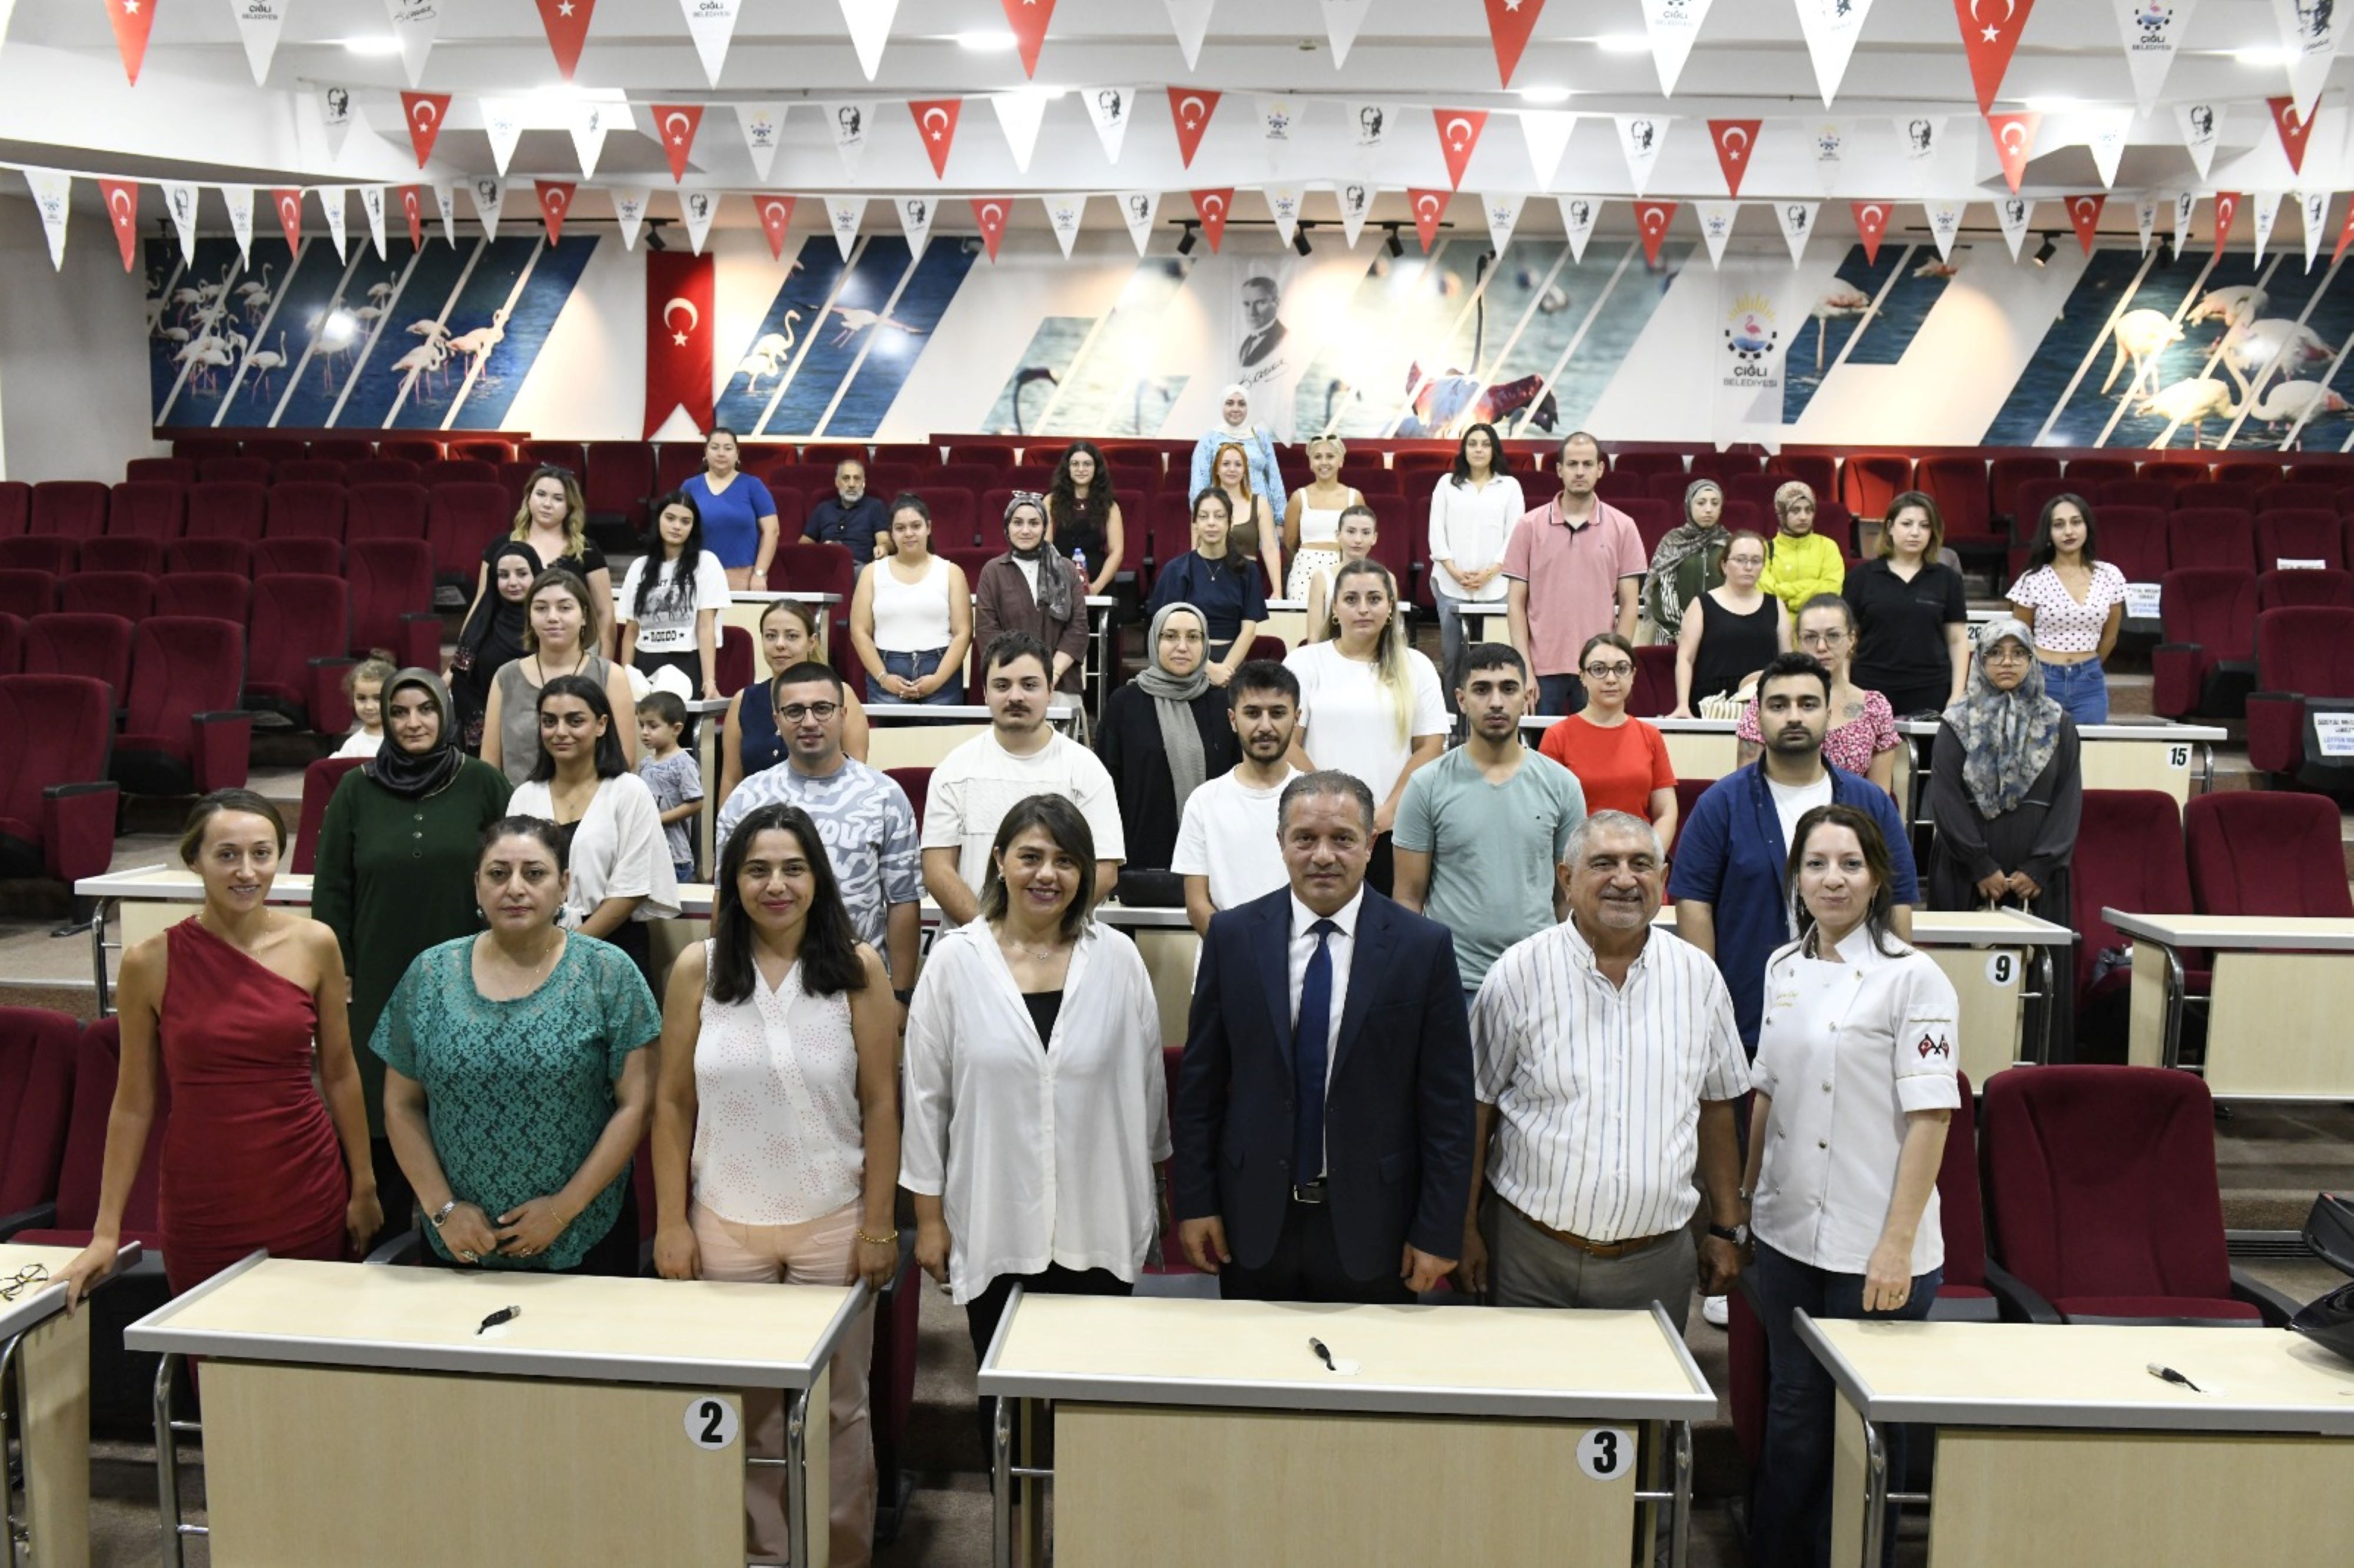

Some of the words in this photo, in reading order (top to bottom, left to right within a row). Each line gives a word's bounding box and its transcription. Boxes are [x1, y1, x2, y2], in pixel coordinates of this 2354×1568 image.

[2171, 747, 2187, 766] 15
[921, 929, 935, 956] 7
[1996, 955, 2011, 982] 9
[700, 1401, 722, 1443] 2
[1593, 1430, 1617, 1473] 3
